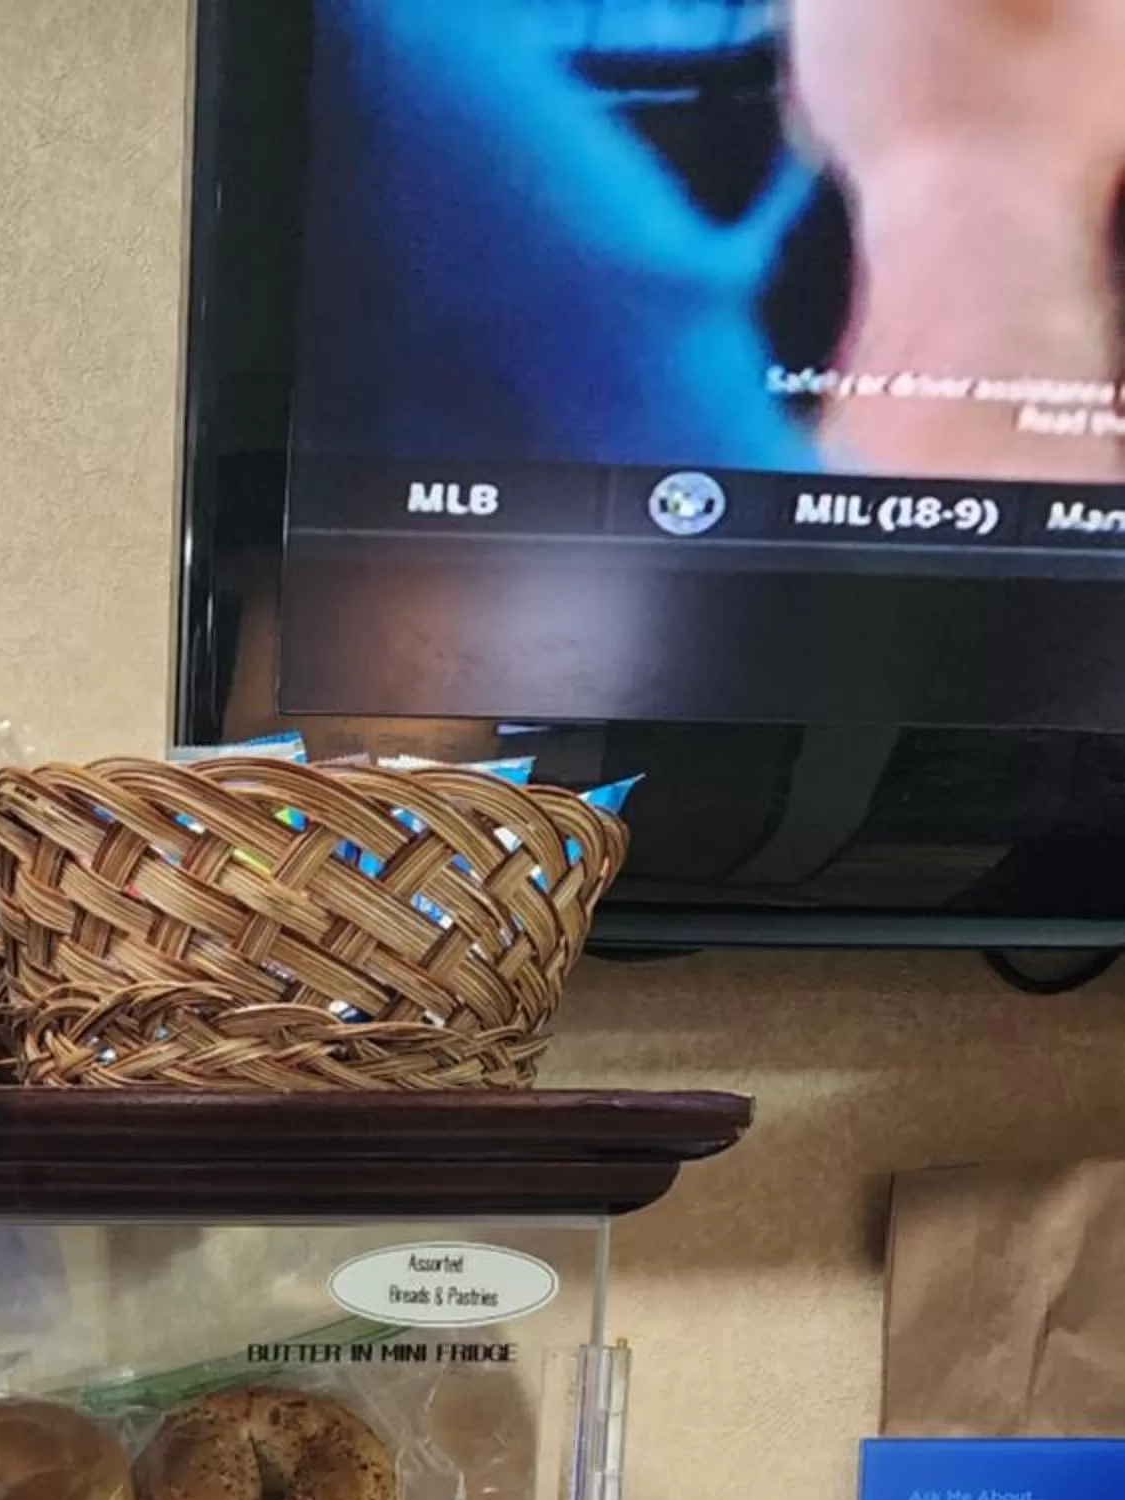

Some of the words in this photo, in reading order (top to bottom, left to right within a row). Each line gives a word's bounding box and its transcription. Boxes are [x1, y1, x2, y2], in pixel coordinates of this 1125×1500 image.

[407, 482, 500, 516] MLB
[794, 493, 872, 526] MIL
[877, 496, 1000, 535] (18-9)
[407, 1252, 464, 1273] Assorted
[389, 1284, 431, 1305] Breads
[447, 1286, 500, 1307] Pastries
[247, 1343, 342, 1363] BUTTER
[350, 1343, 373, 1362] IN
[380, 1343, 428, 1363] MINI
[435, 1343, 519, 1363] FRIDGE
